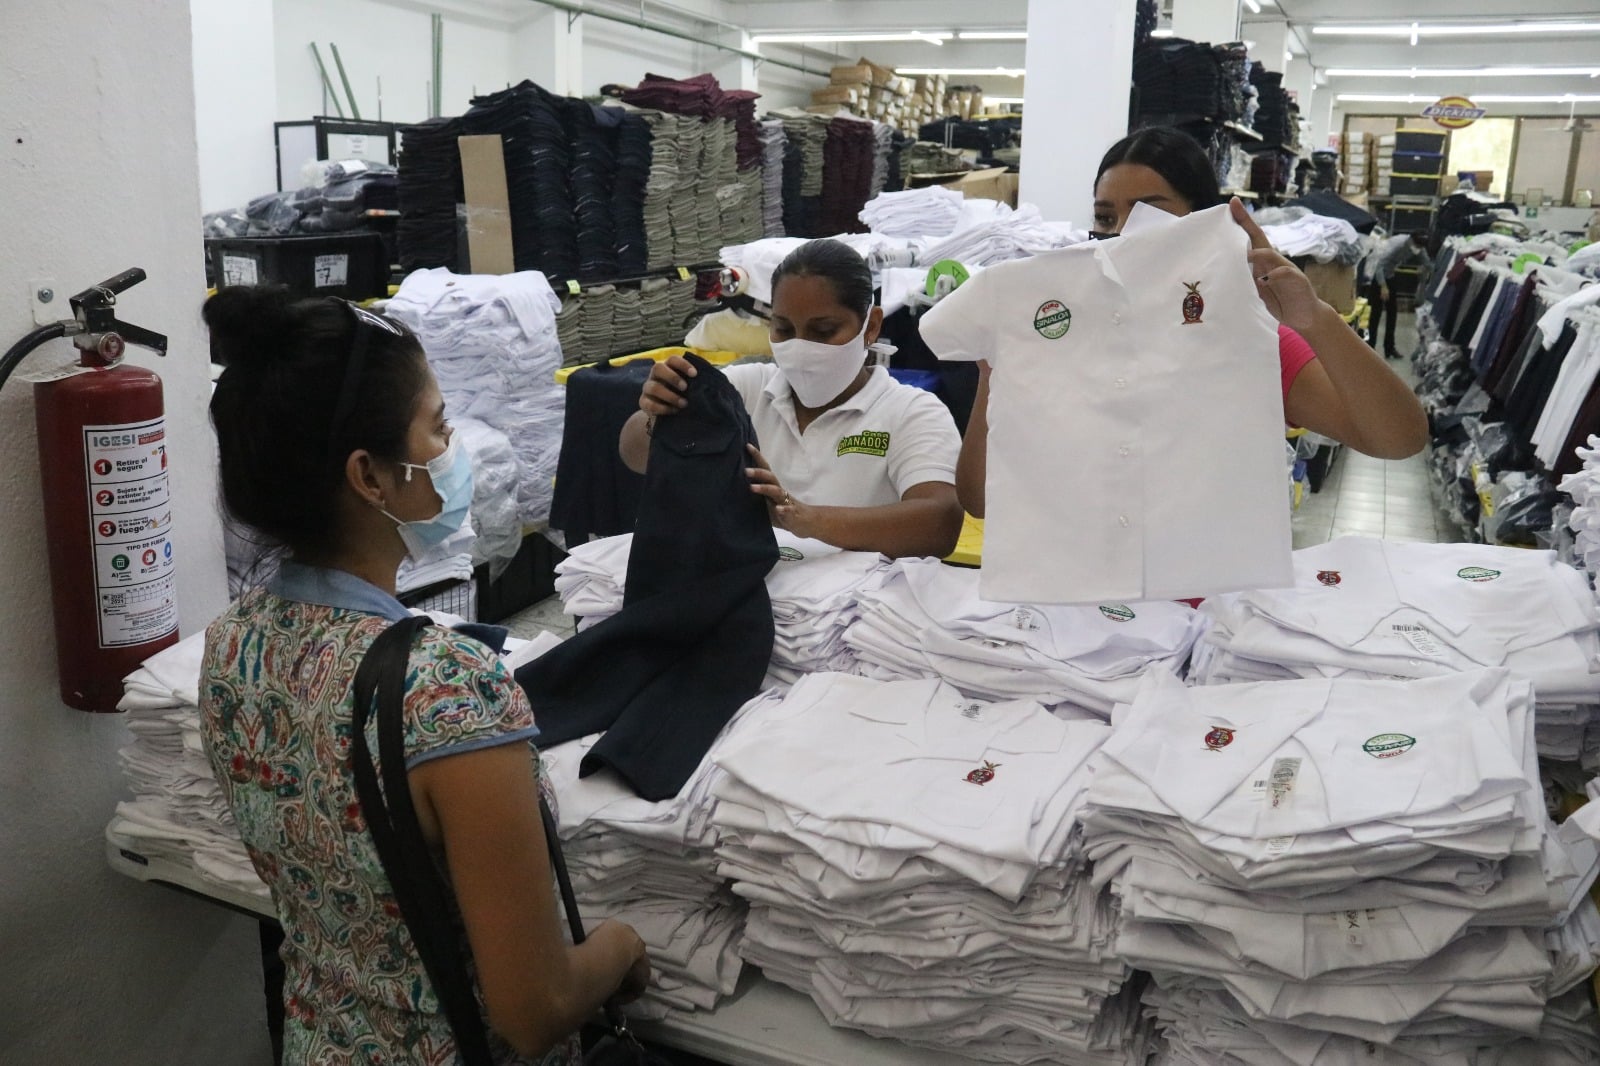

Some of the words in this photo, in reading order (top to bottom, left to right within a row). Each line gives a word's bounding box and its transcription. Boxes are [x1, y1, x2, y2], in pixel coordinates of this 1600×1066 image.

[1431, 107, 1478, 117] Dickies
[1042, 303, 1059, 313] PURO
[1036, 311, 1069, 328] SINALOA
[116, 459, 140, 467] Retire
[116, 464, 143, 472] seguro
[119, 525, 145, 534] fuego
